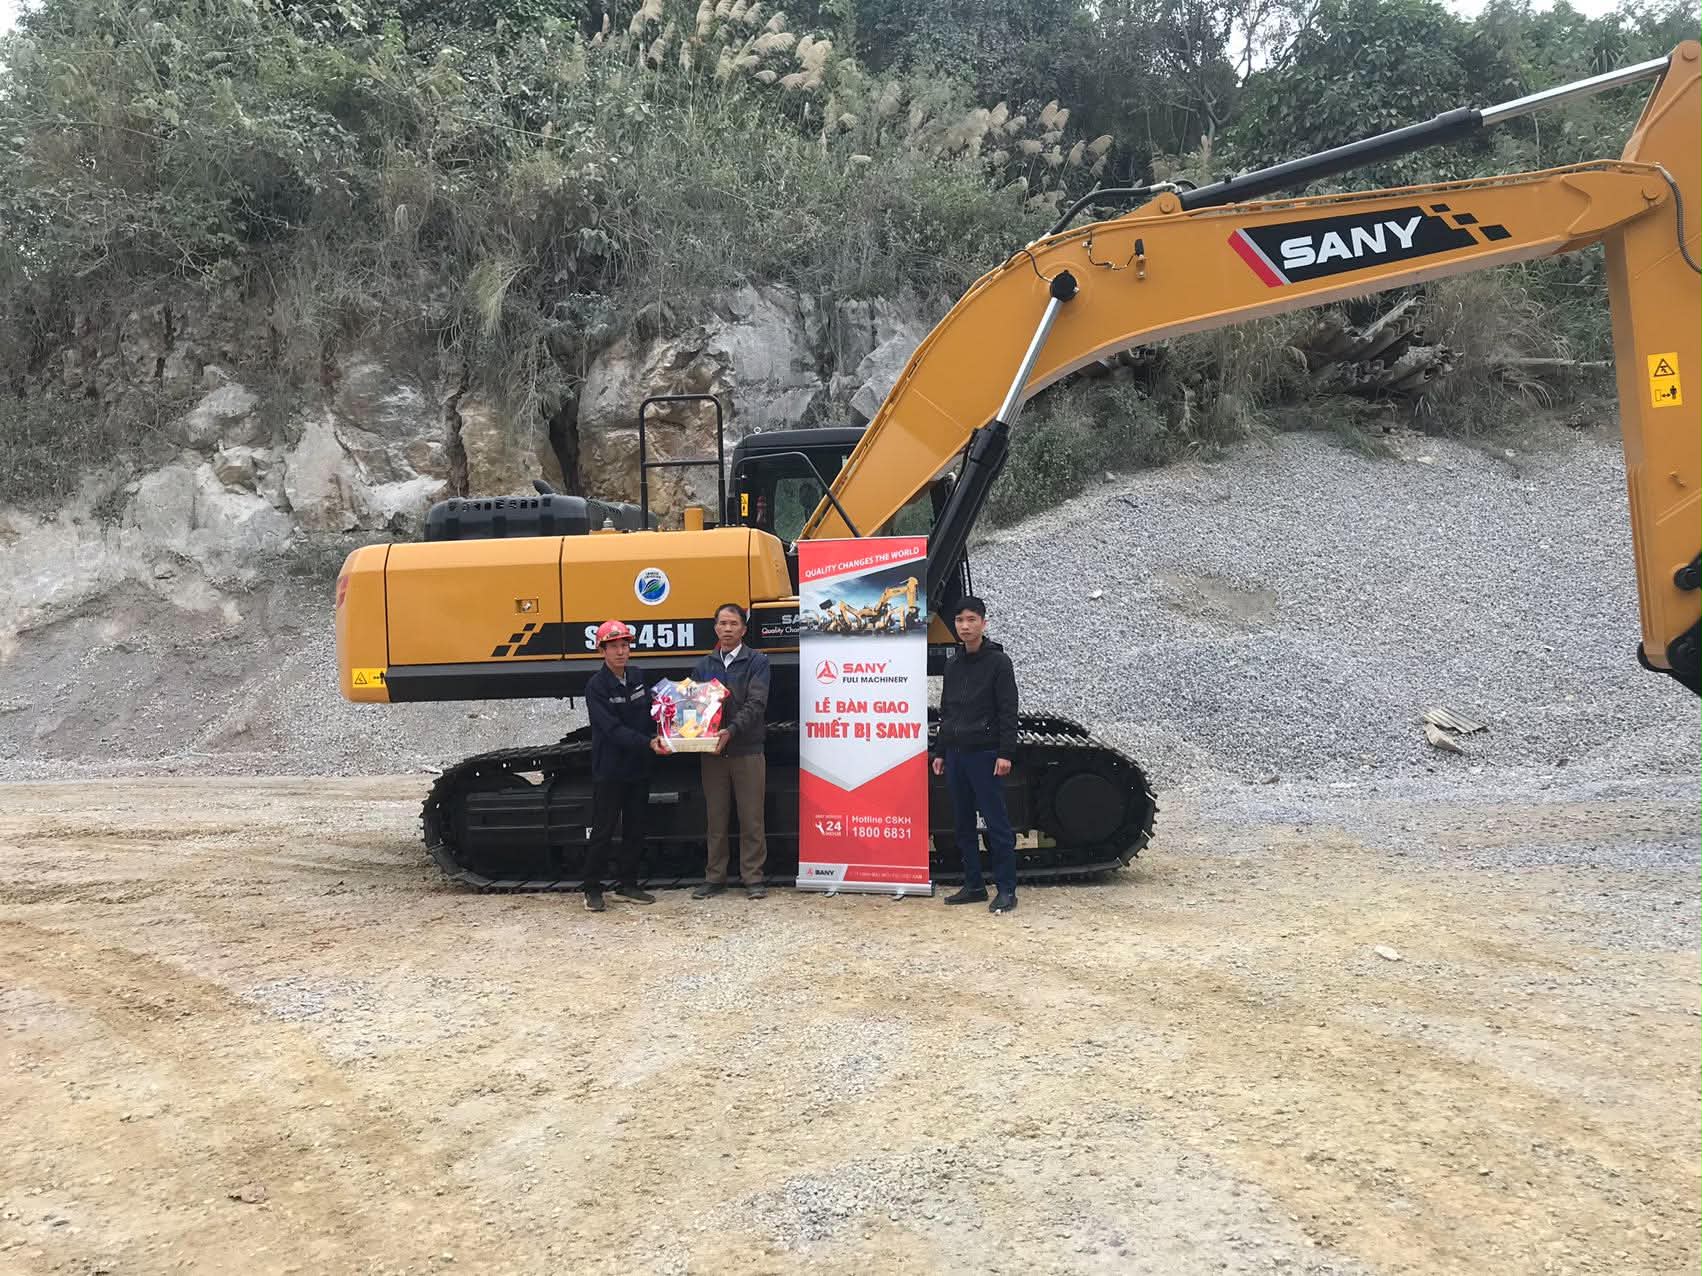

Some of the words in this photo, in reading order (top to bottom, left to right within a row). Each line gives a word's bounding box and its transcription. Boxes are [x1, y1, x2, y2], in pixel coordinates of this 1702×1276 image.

[1280, 215, 1423, 270] SANY
[805, 564, 837, 577] QUALITY
[838, 556, 874, 570] CHANGES
[875, 553, 890, 563] THE
[891, 546, 920, 560] WORLD
[781, 614, 800, 625] SA
[584, 623, 694, 650] S245H
[761, 626, 784, 636] Quality
[842, 663, 887, 673] SANY
[815, 696, 831, 713] LỄ
[836, 698, 867, 713] BÀN
[873, 701, 909, 714] GIAO
[806, 717, 850, 738] THIẾT
[854, 722, 871, 741] BỊ
[876, 722, 921, 739] SANY
[826, 821, 842, 831] 24
[852, 815, 883, 824] Hotline
[885, 816, 912, 825] CSKH
[852, 827, 880, 838] 1800
[884, 828, 912, 839] 6831
